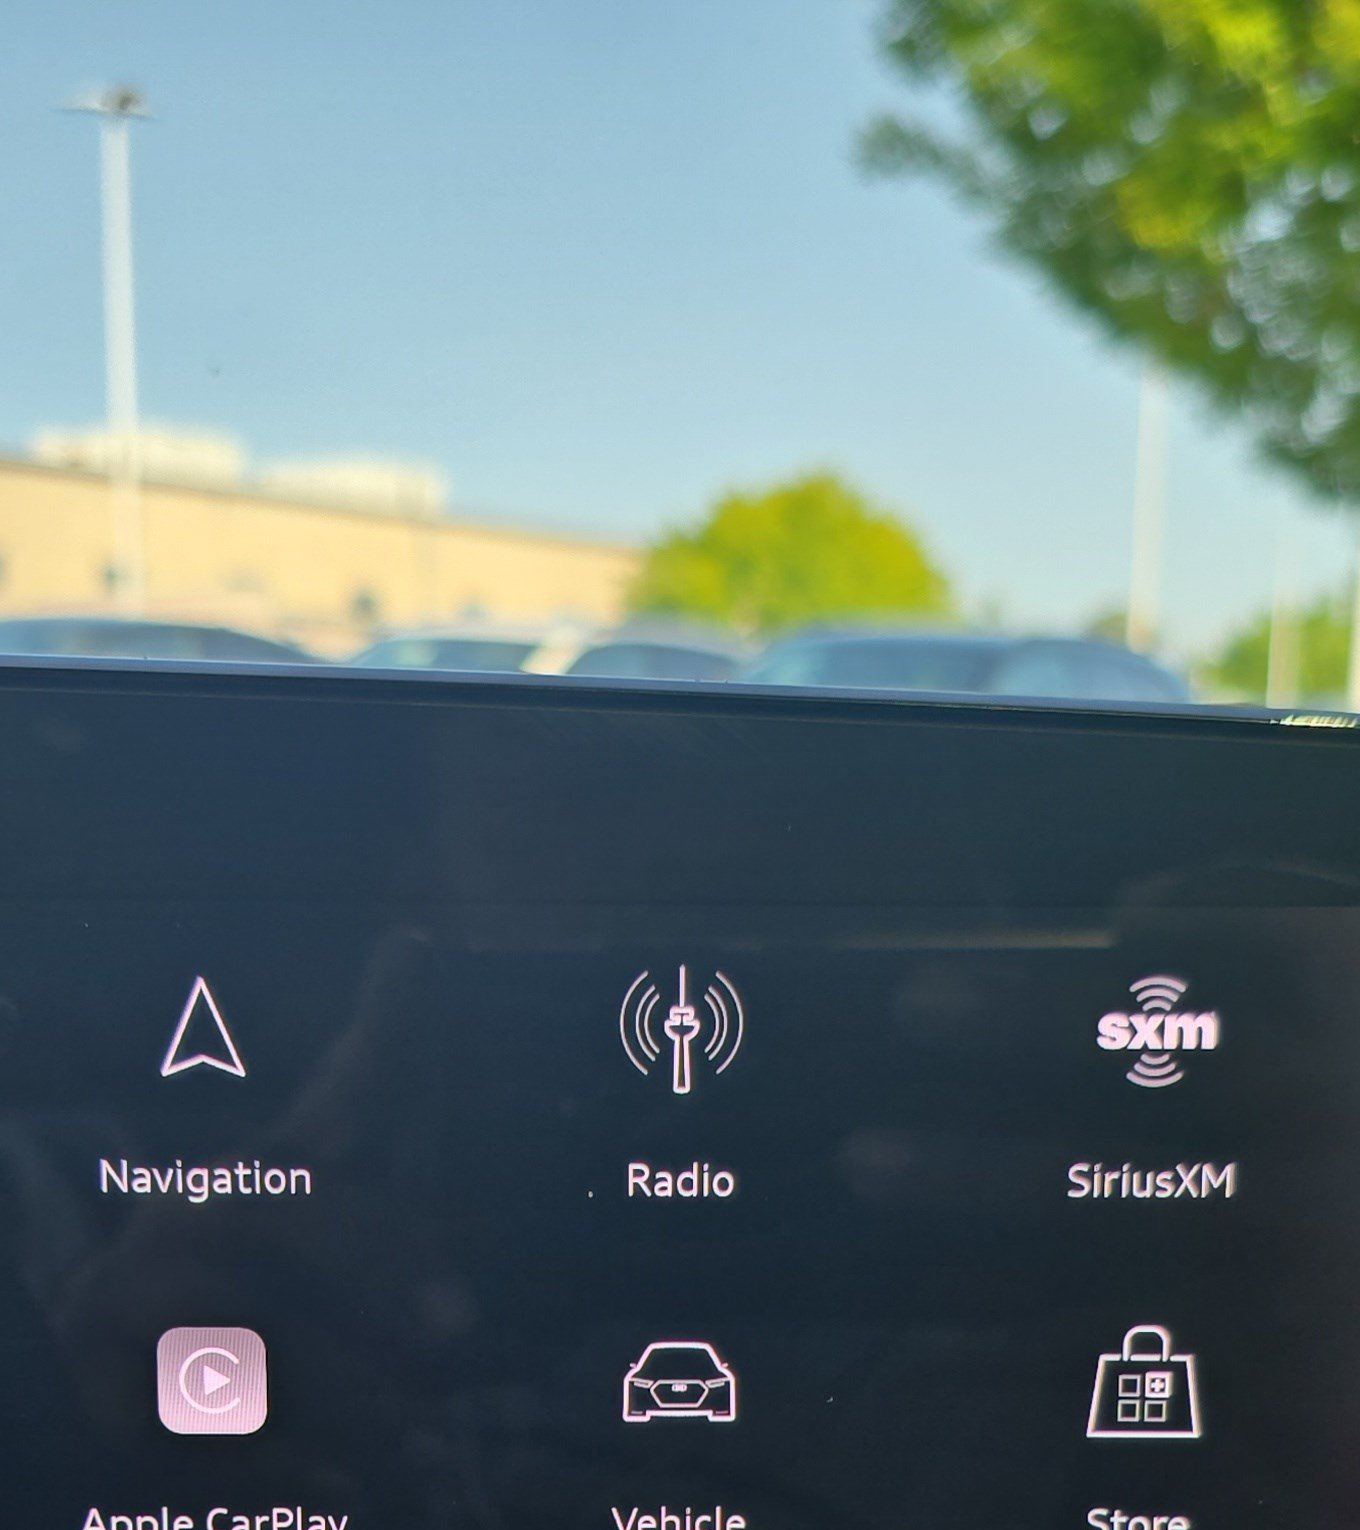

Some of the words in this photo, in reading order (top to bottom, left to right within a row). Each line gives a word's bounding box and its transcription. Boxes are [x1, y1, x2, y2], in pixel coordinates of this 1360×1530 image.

[1096, 1011, 1219, 1050] sxm
[99, 1158, 311, 1204] Navigation
[628, 1161, 735, 1198] Radio
[1067, 1162, 1236, 1199] SiriusXM
